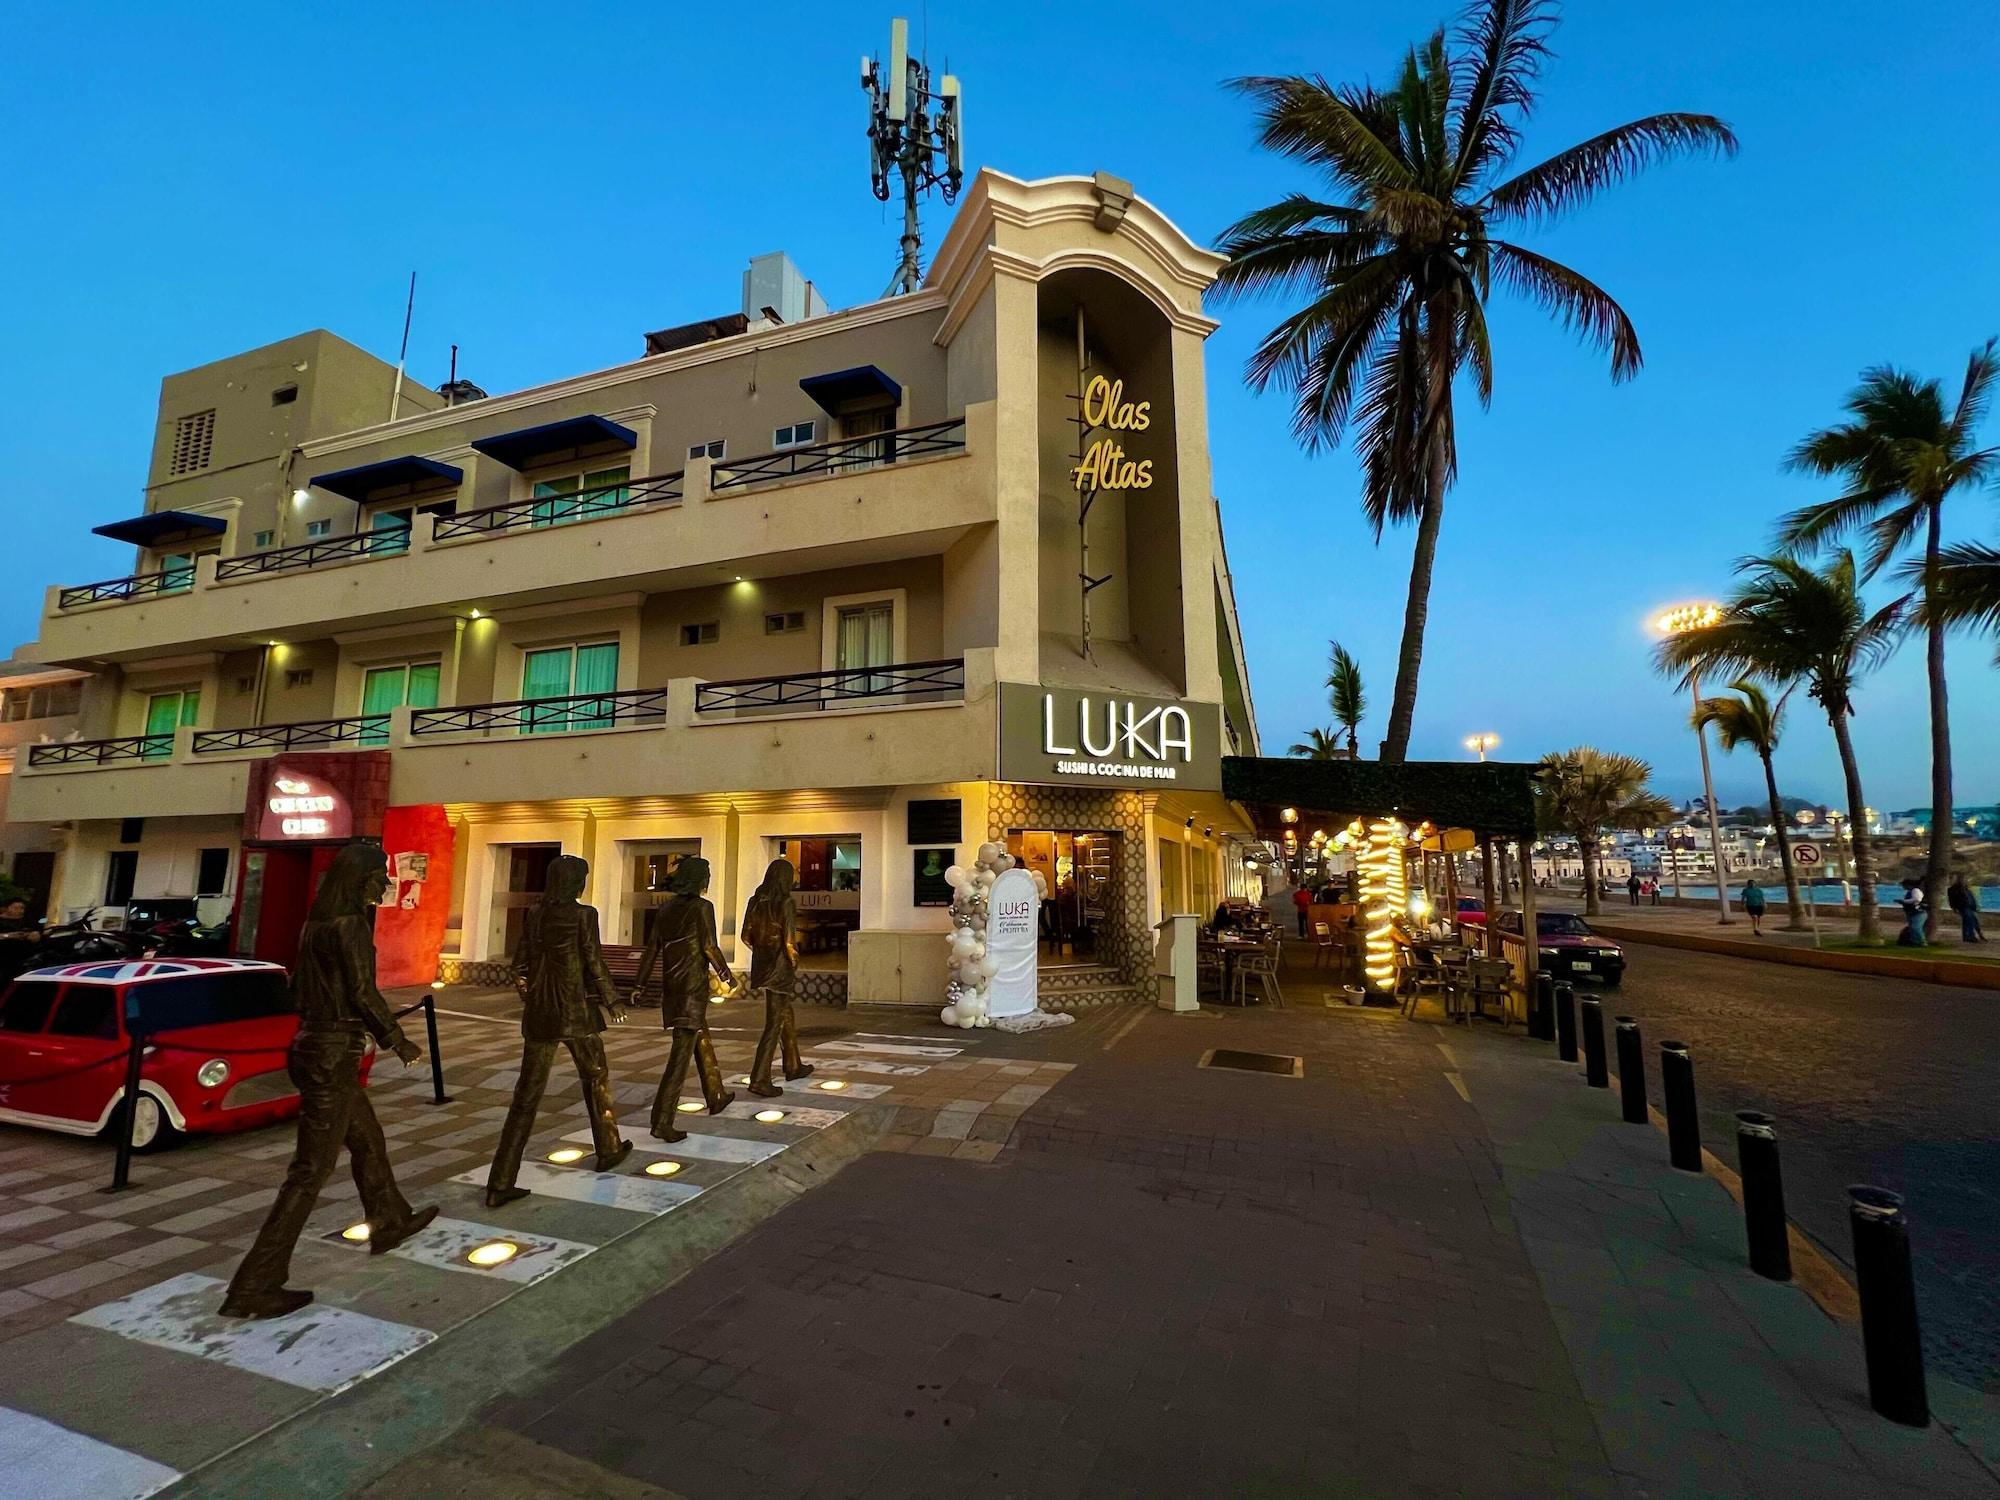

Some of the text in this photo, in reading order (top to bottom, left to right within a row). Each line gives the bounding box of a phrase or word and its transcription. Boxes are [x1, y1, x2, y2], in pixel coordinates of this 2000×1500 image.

[1084, 374, 1151, 431] Olas
[1073, 438, 1153, 491] Altas
[1046, 693, 1192, 763] LUKA
[1057, 760, 1088, 774] SUSHI
[1089, 763, 1097, 775] &
[1140, 766, 1153, 778] DE
[1154, 766, 1176, 780] MAR
[999, 901, 1029, 915] LUKA
